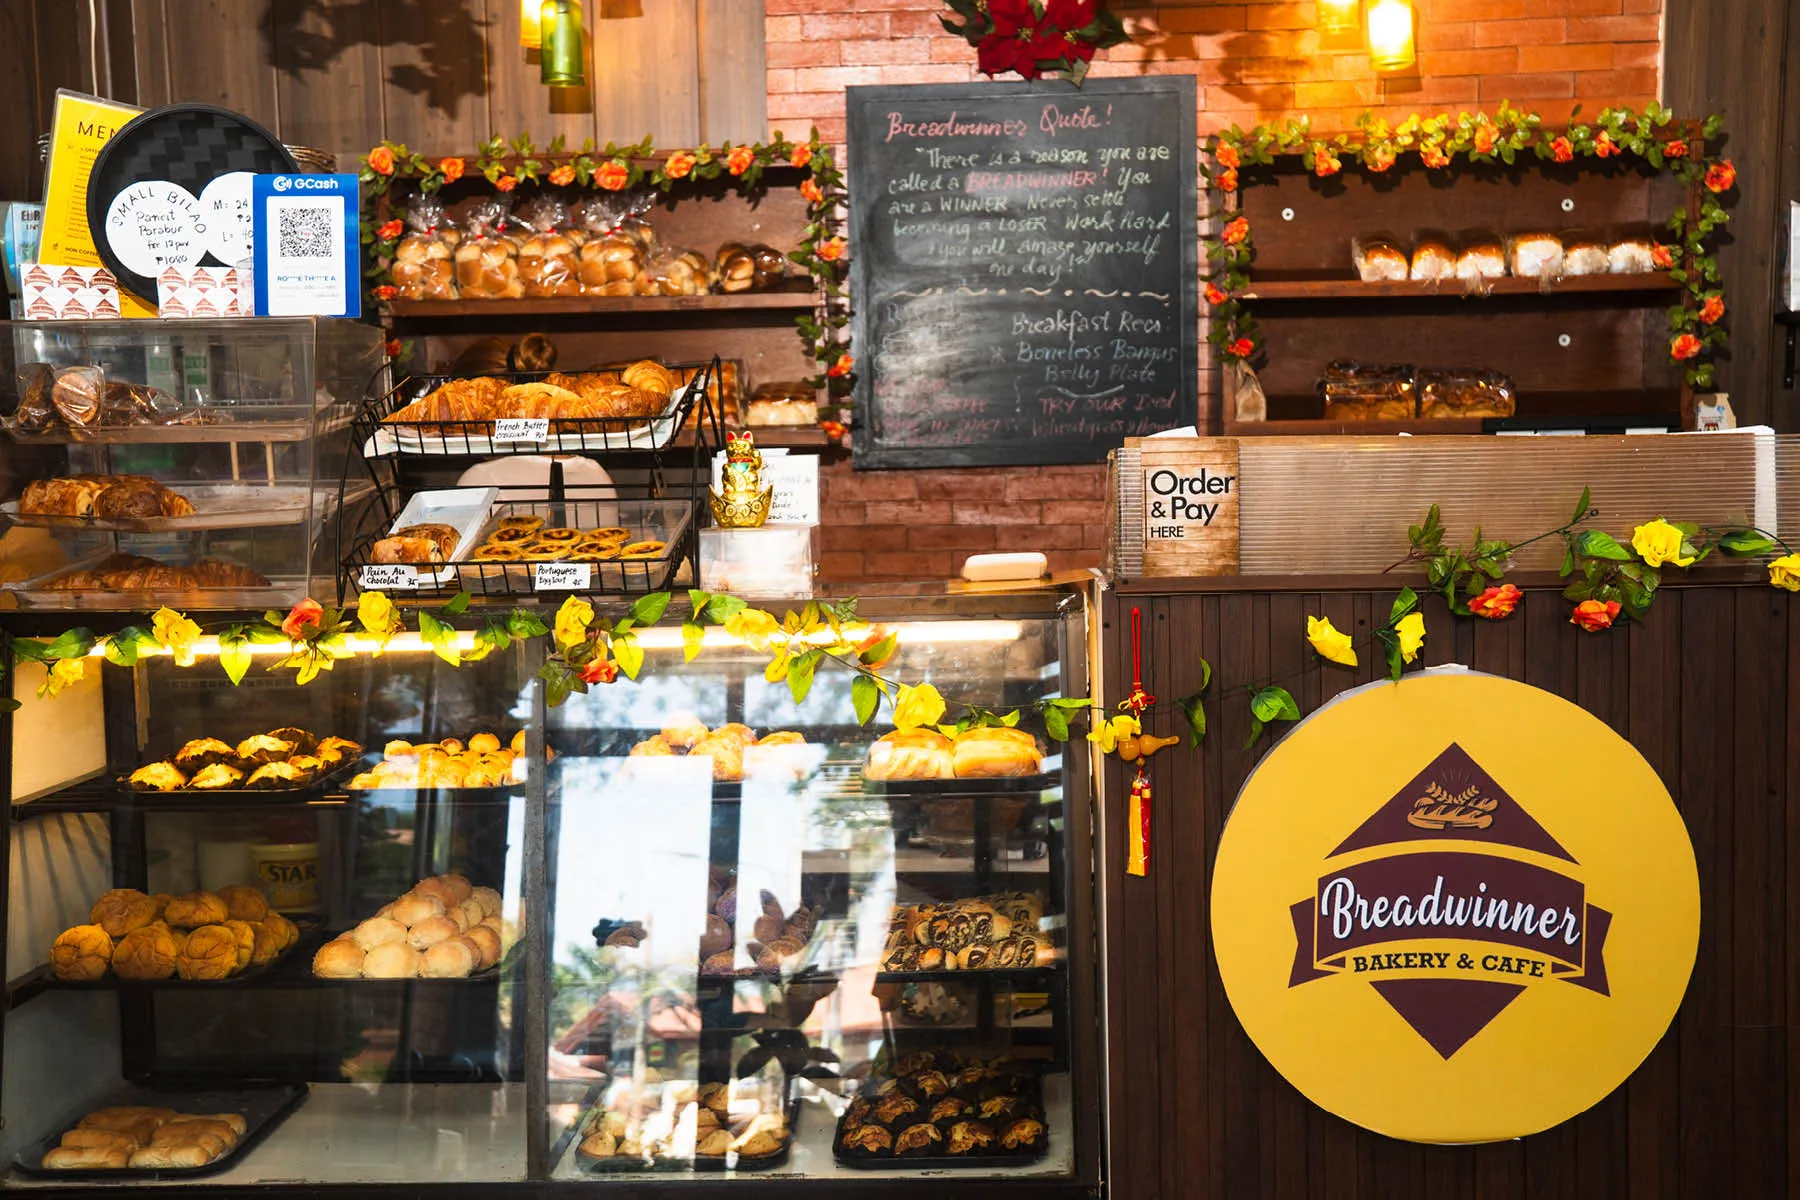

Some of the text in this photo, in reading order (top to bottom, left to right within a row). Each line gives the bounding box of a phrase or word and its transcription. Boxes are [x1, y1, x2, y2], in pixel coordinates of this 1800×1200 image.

[1007, 151, 1022, 165] a
[1097, 147, 1131, 168] you
[1136, 145, 1170, 161] are
[294, 178, 339, 189] GCash
[888, 171, 943, 195] called
[112, 187, 156, 226] SMALL
[167, 191, 207, 234] BILAO
[940, 196, 1009, 213] WINNER
[1065, 210, 1115, 232] Work
[1012, 309, 1111, 341] Breakfast
[1016, 340, 1103, 363] Boneless
[1150, 468, 1236, 495] Order
[1151, 496, 1219, 527] & Pay
[1150, 526, 1184, 538] HERE
[367, 566, 406, 576] Pain Au
[267, 864, 317, 884] STAR
[1320, 875, 1582, 945] Breadwinner
[1353, 952, 1546, 978] BAKERY & CAFE
